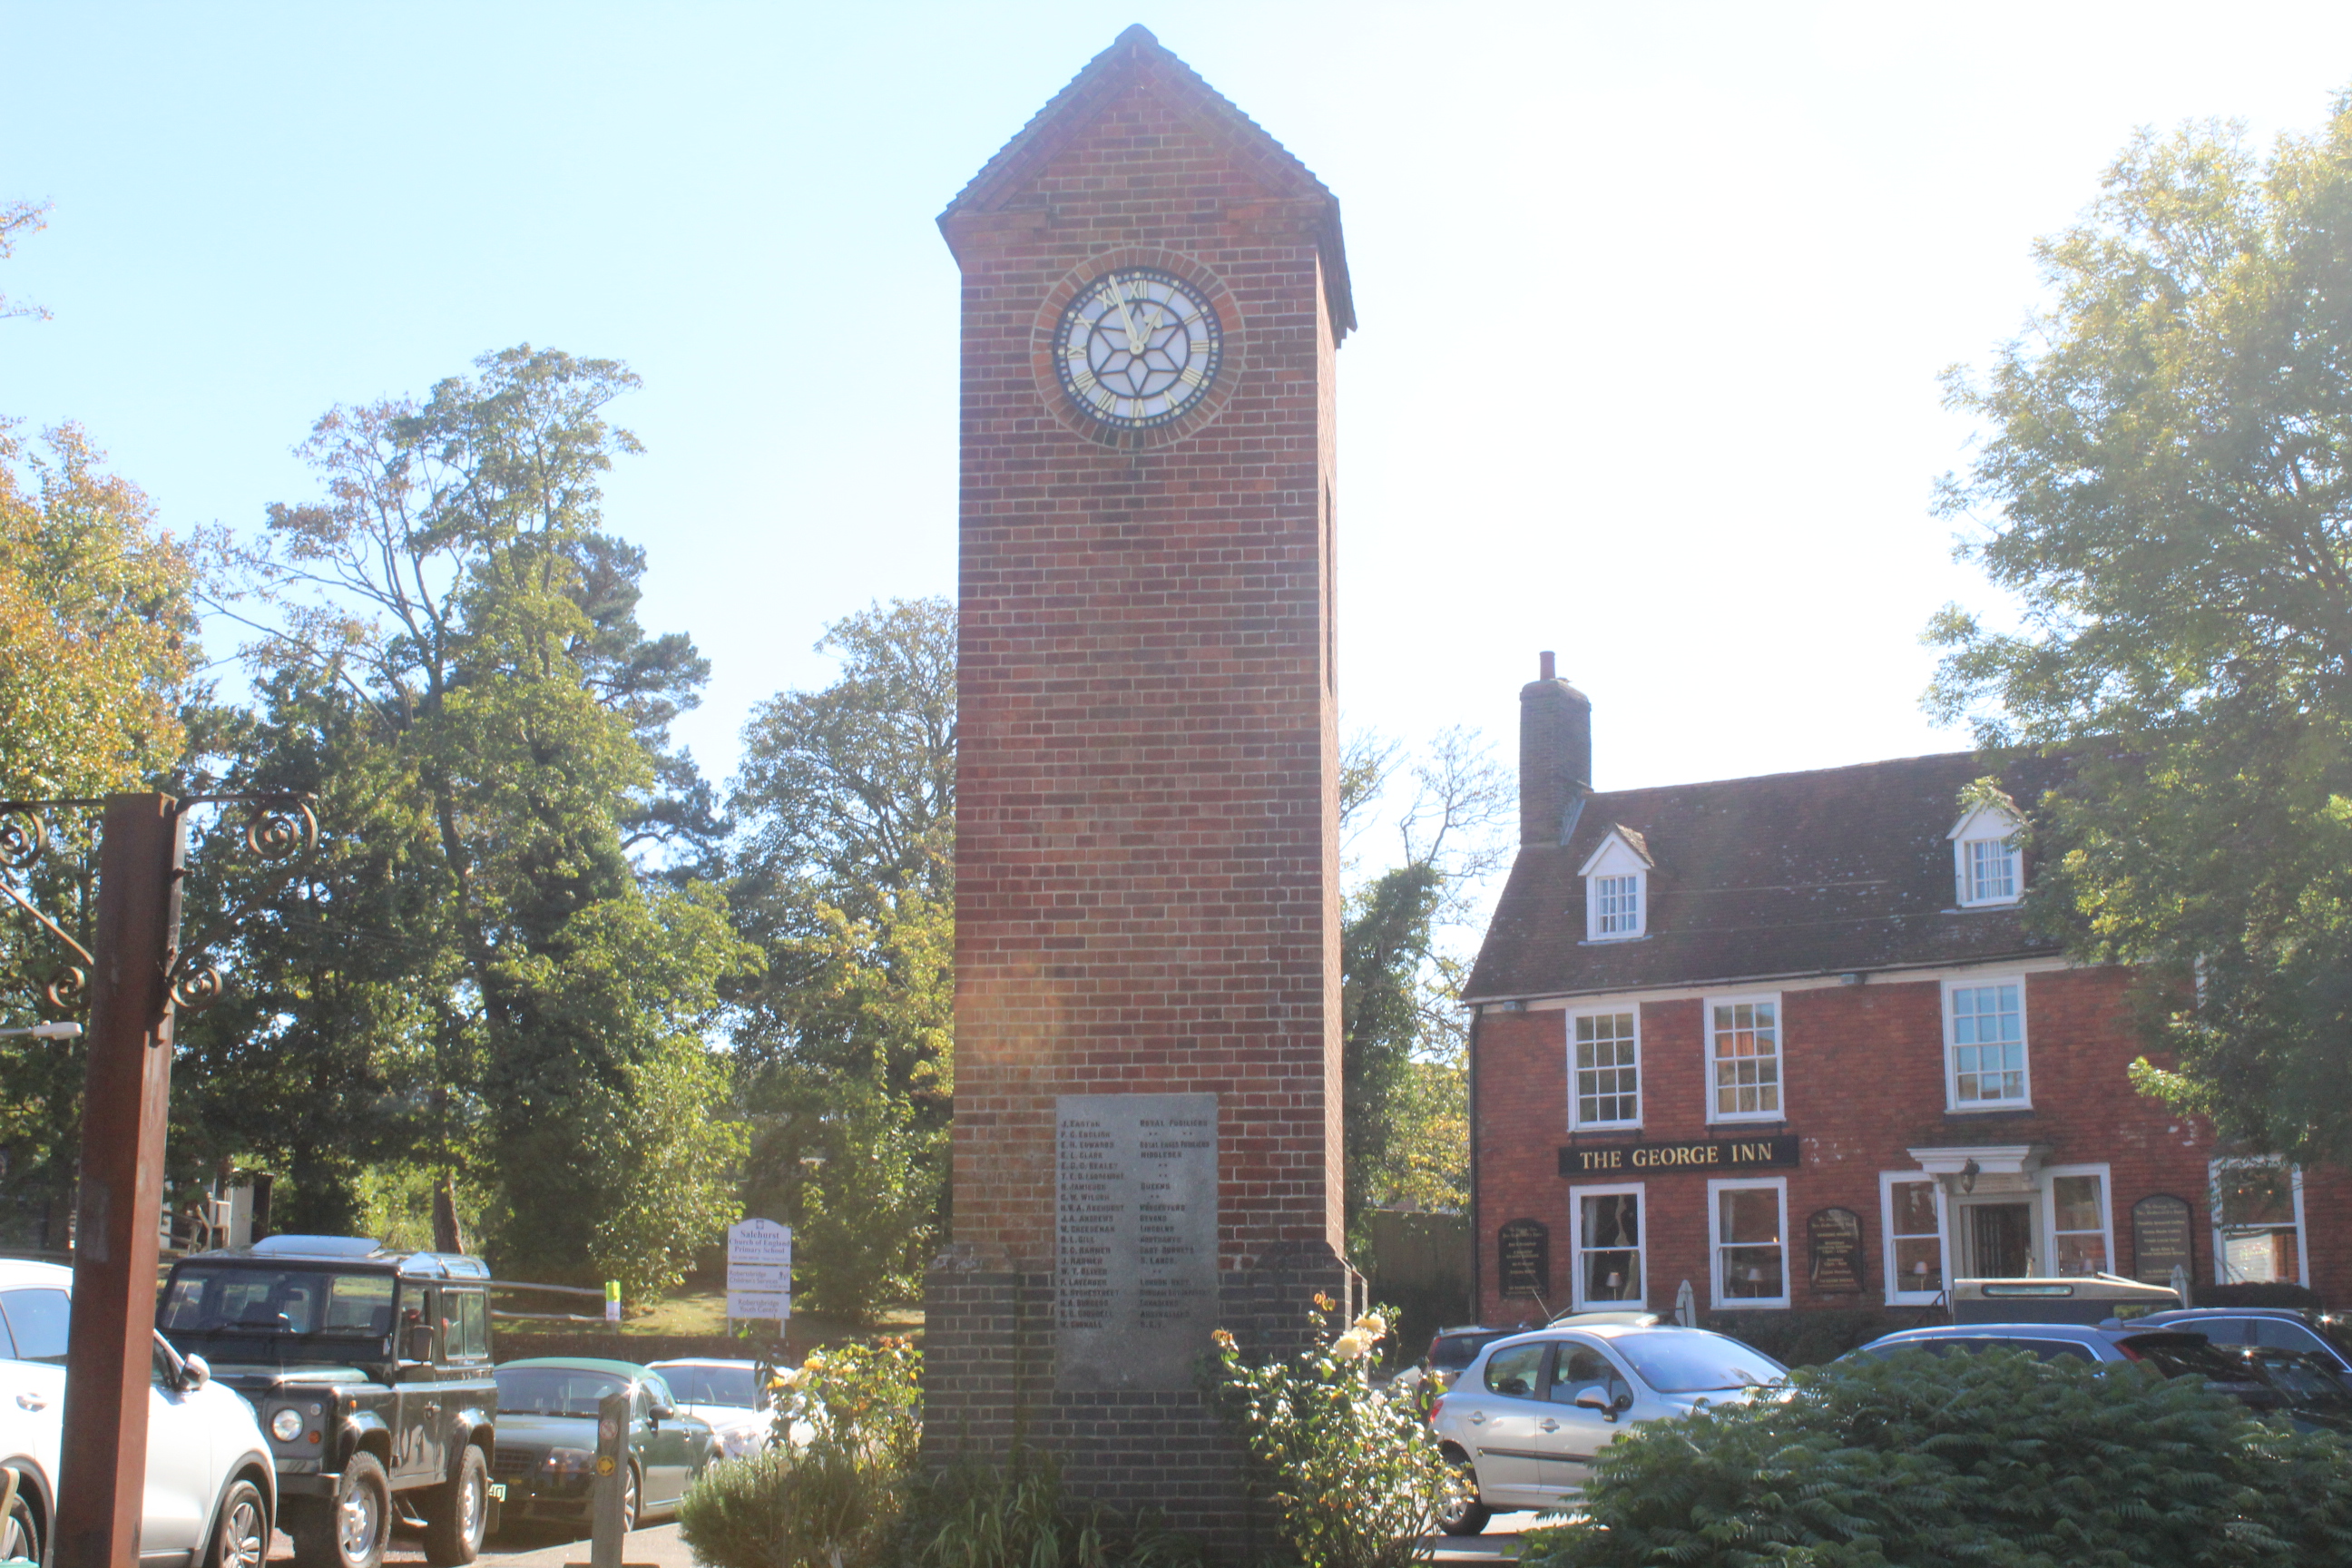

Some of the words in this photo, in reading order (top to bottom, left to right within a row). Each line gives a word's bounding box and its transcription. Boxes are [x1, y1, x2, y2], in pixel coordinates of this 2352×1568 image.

[1140, 1119, 1164, 1127] ROYAL
[1169, 1119, 1208, 1127] FUSILIERS
[1080, 1141, 1114, 1149] EDWARDS
[1580, 1151, 1622, 1170] THE
[1632, 1145, 1720, 1168] GEORGE
[1731, 1142, 1773, 1162] INN
[1081, 1193, 1110, 1201] WILSON
[740, 1230, 779, 1240] Salehurst
[763, 1240, 790, 1248] England
[734, 1246, 761, 1254] Primary
[738, 1298, 779, 1307] Robertsbridge
